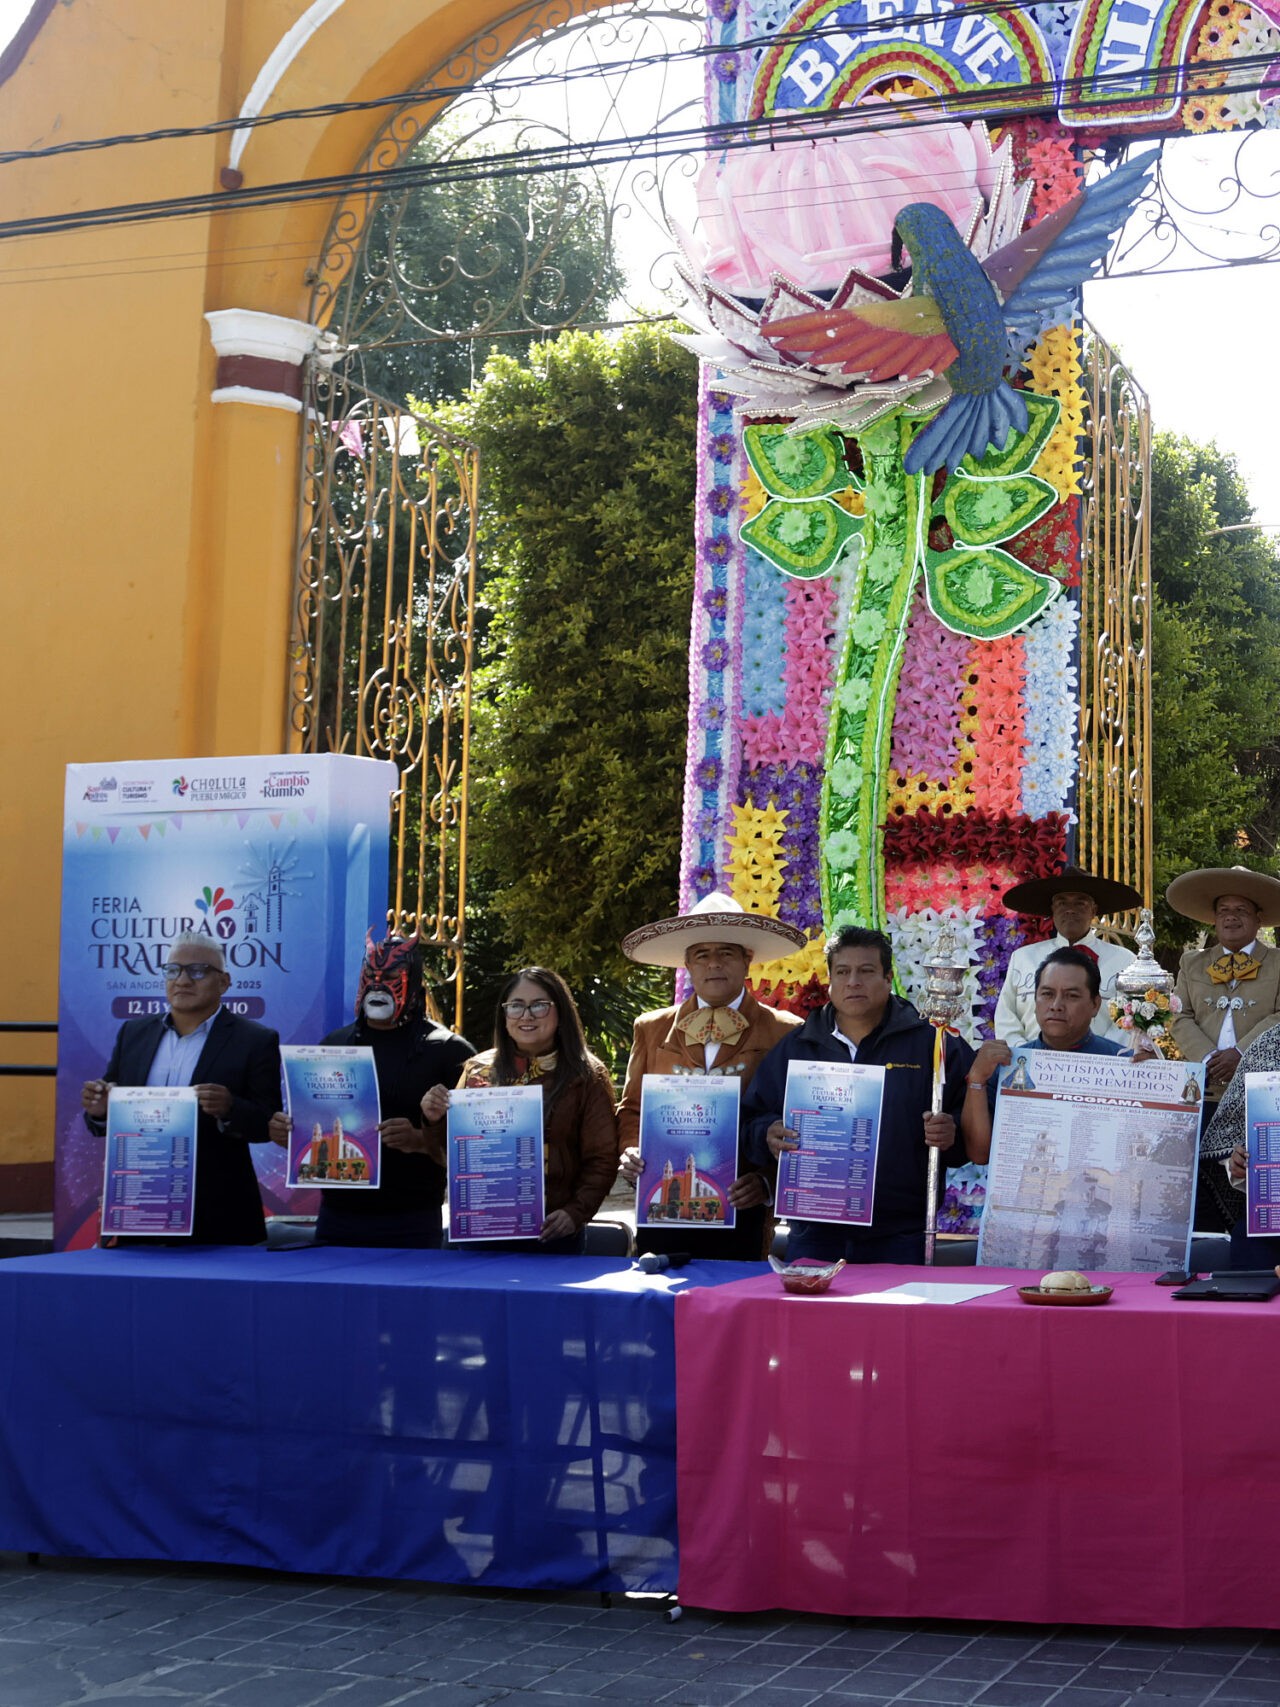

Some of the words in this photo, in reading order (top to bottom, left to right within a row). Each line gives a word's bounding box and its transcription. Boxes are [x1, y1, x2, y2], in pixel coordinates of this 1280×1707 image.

[269, 775, 310, 788] Cambio
[263, 786, 305, 798] Rumbo
[92, 897, 142, 913] FERIA
[91, 917, 213, 939] CULTURA
[219, 920, 234, 938] Y
[106, 981, 128, 990] SAN
[236, 980, 262, 990] 2025
[128, 1001, 145, 1016] 12,
[147, 1001, 161, 1015] 13
[1038, 1073, 1061, 1082] DE
[1063, 1074, 1091, 1085] LOS
[1095, 1078, 1174, 1093] REMEDIOS
[1121, 1069, 1180, 1082] VIRGEN
[1052, 1093, 1144, 1108] PROGRAMA
